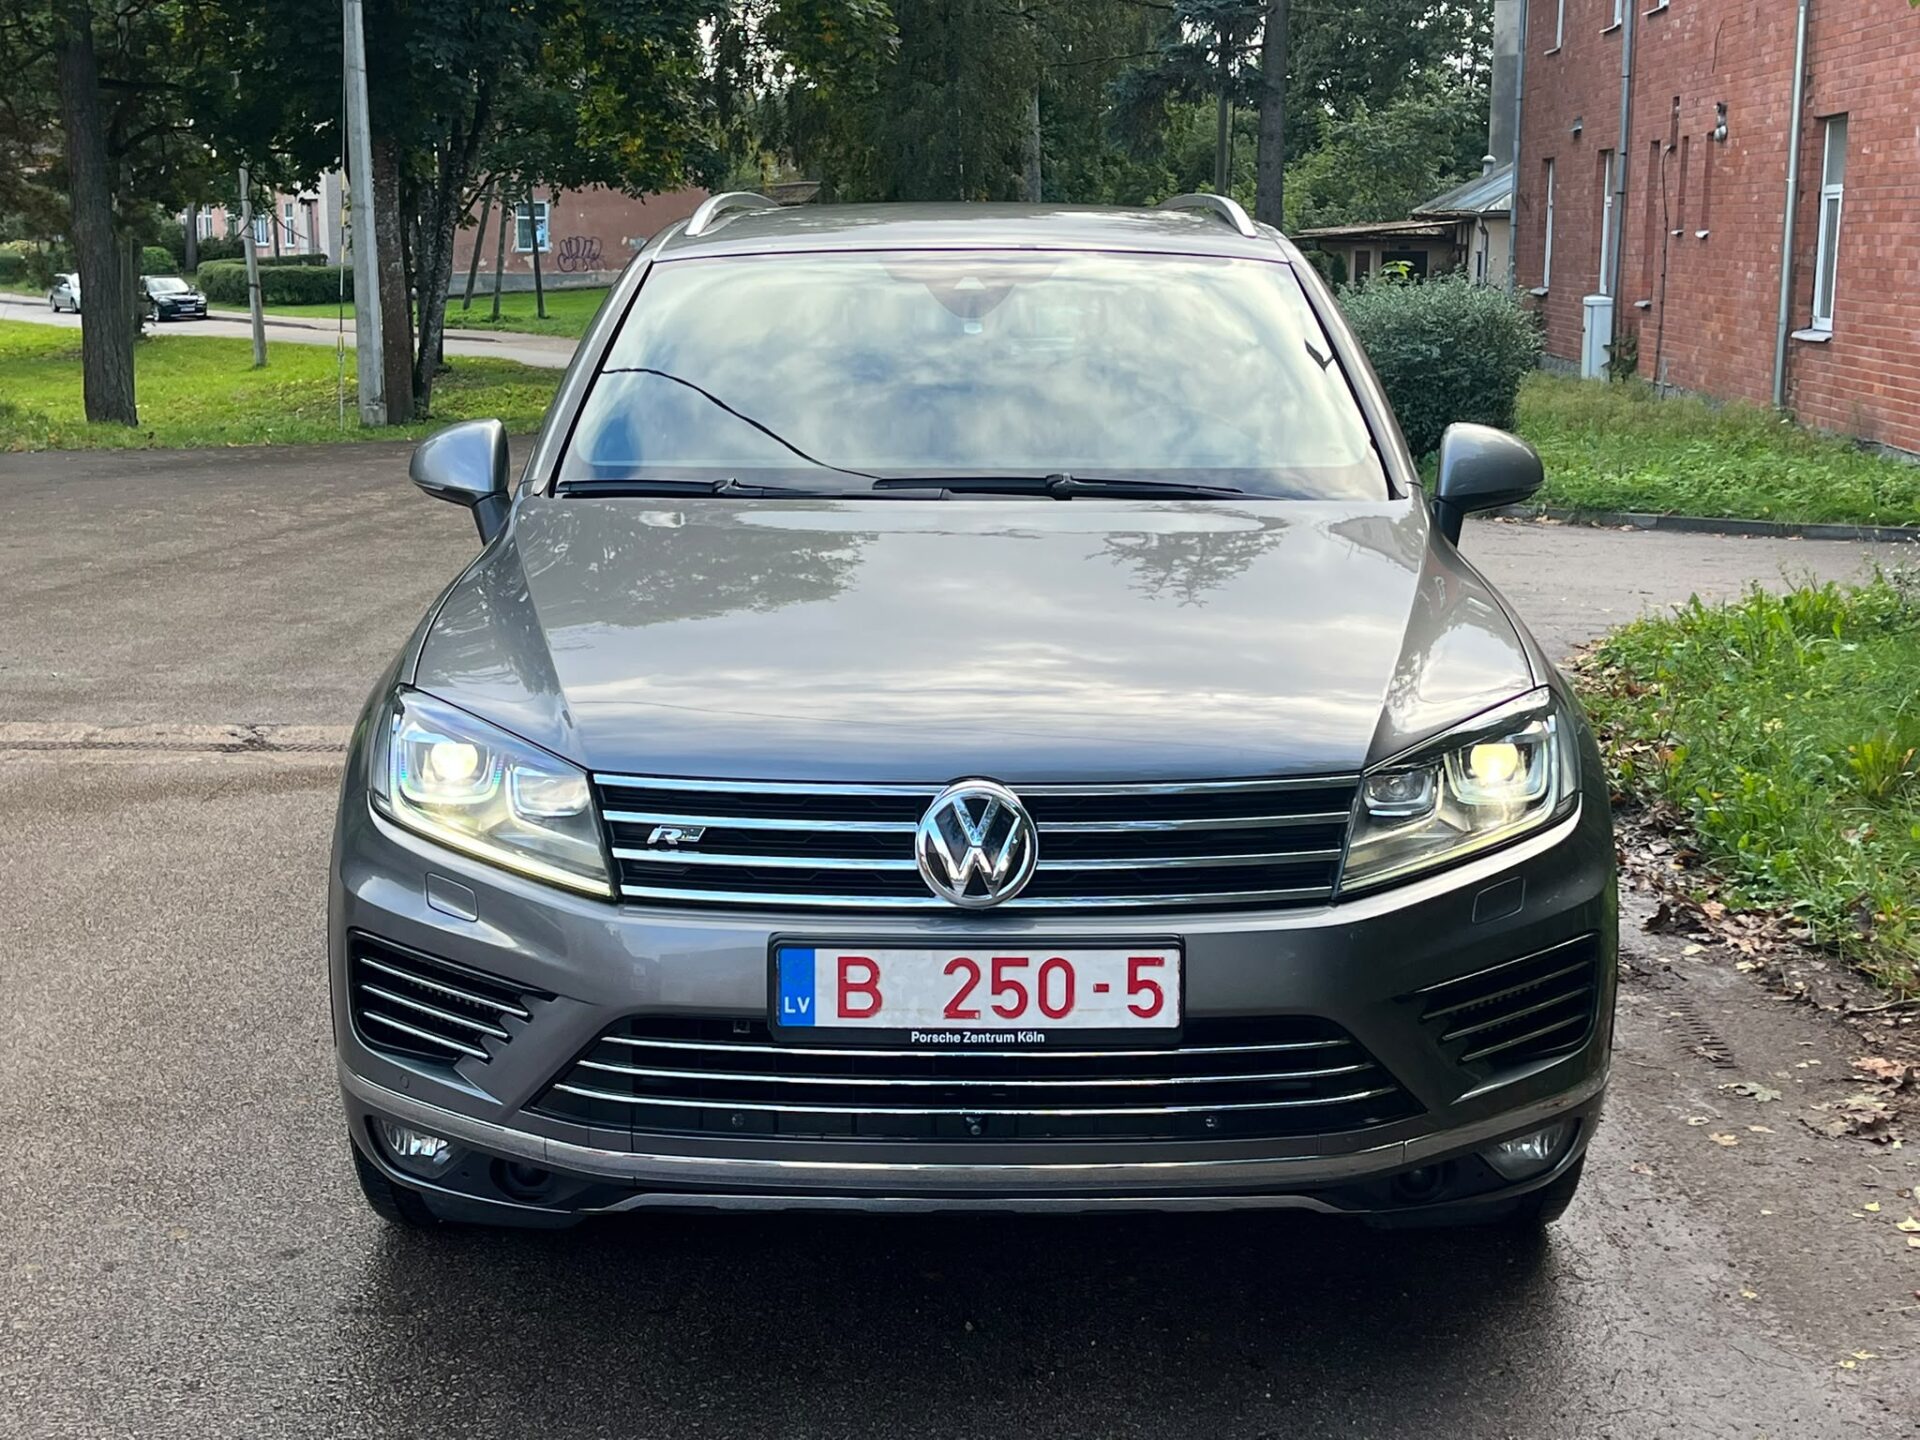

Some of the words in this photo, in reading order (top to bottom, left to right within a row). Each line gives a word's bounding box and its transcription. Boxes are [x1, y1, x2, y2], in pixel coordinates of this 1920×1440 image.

[921, 792, 1032, 902] VW
[784, 996, 810, 1014] LV
[837, 956, 883, 1018] B
[911, 1031, 961, 1043] Porsche
[963, 1031, 1015, 1043] Zentrum
[1017, 1031, 1045, 1043] Köln
